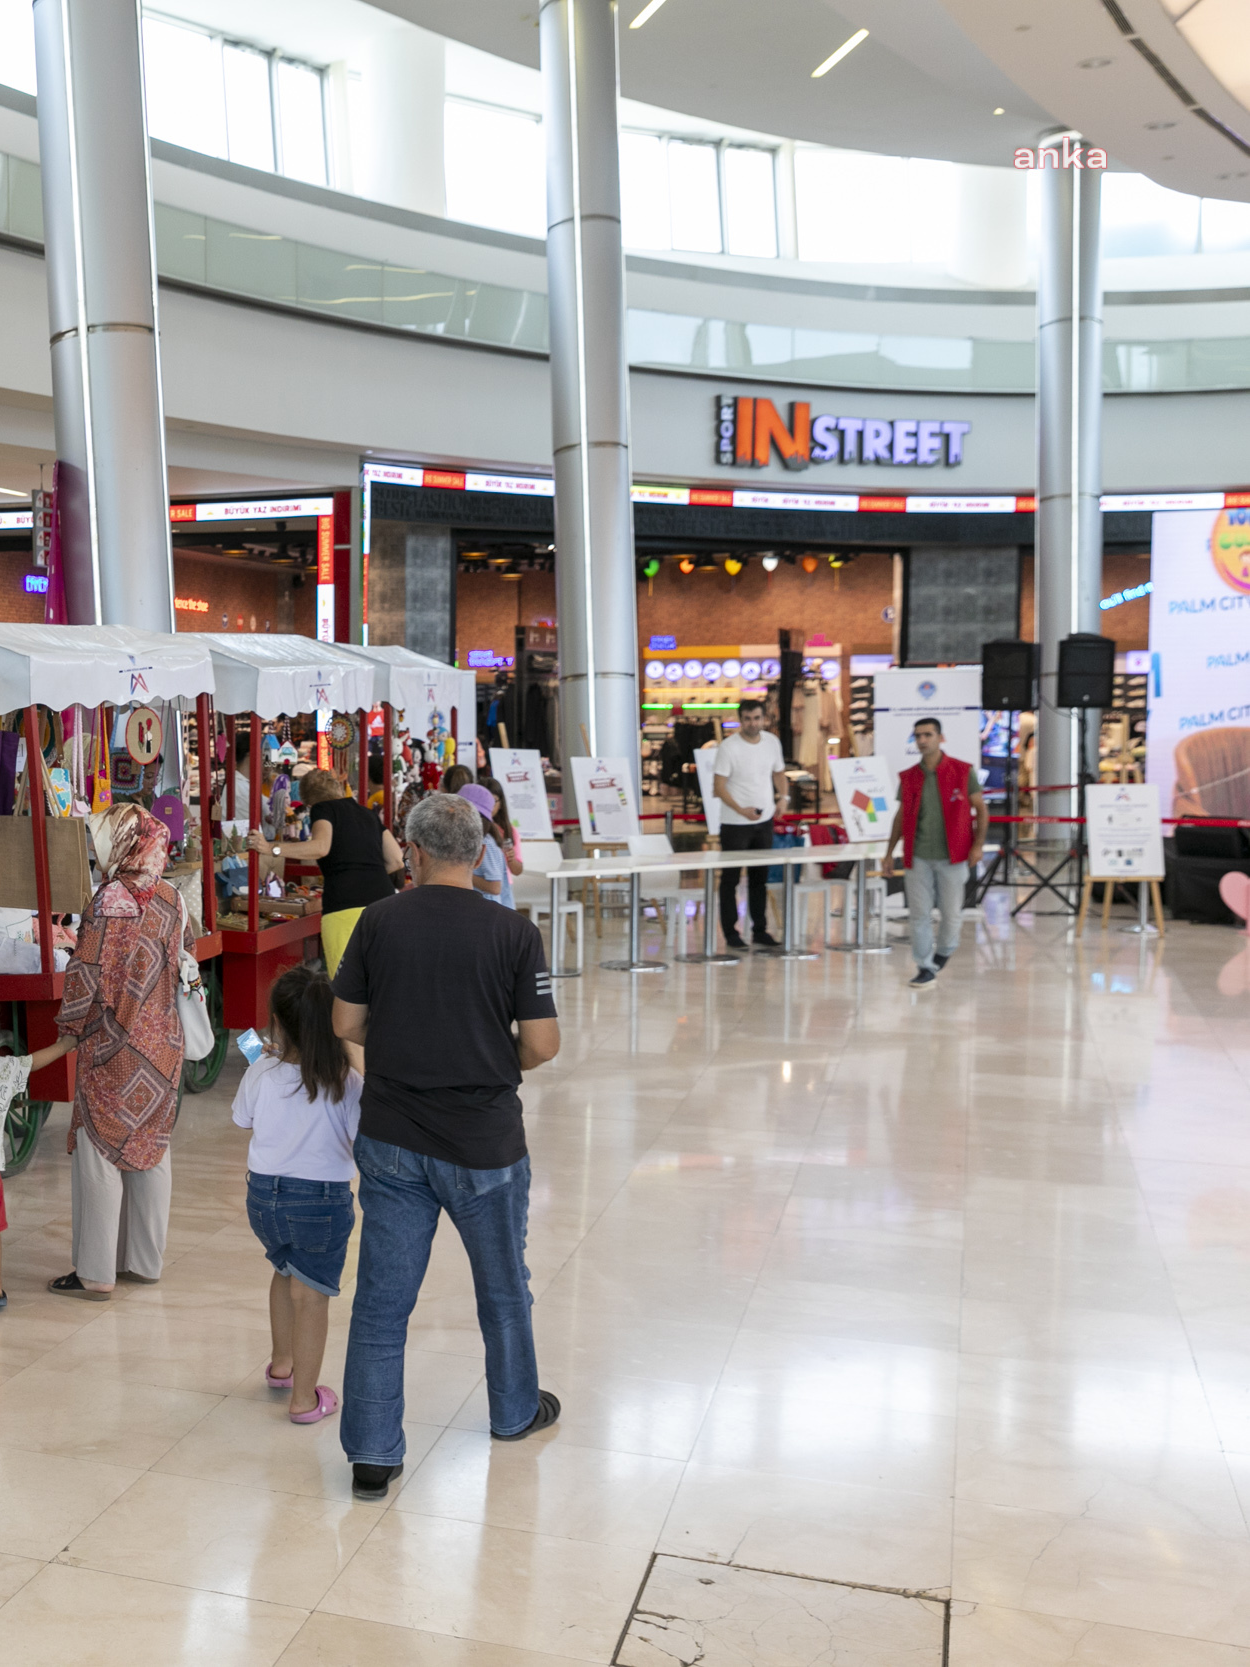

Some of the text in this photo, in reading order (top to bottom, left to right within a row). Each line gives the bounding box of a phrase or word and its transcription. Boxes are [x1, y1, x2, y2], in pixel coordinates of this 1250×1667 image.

[718, 395, 735, 465] SPORT
[735, 396, 971, 470] IN STREET
[176, 508, 193, 519] SALE
[253, 506, 266, 514] YAZ
[1168, 598, 1217, 615] PALM
[321, 618, 330, 642] BÜYÜ
[1178, 704, 1250, 730] PALM CIT
